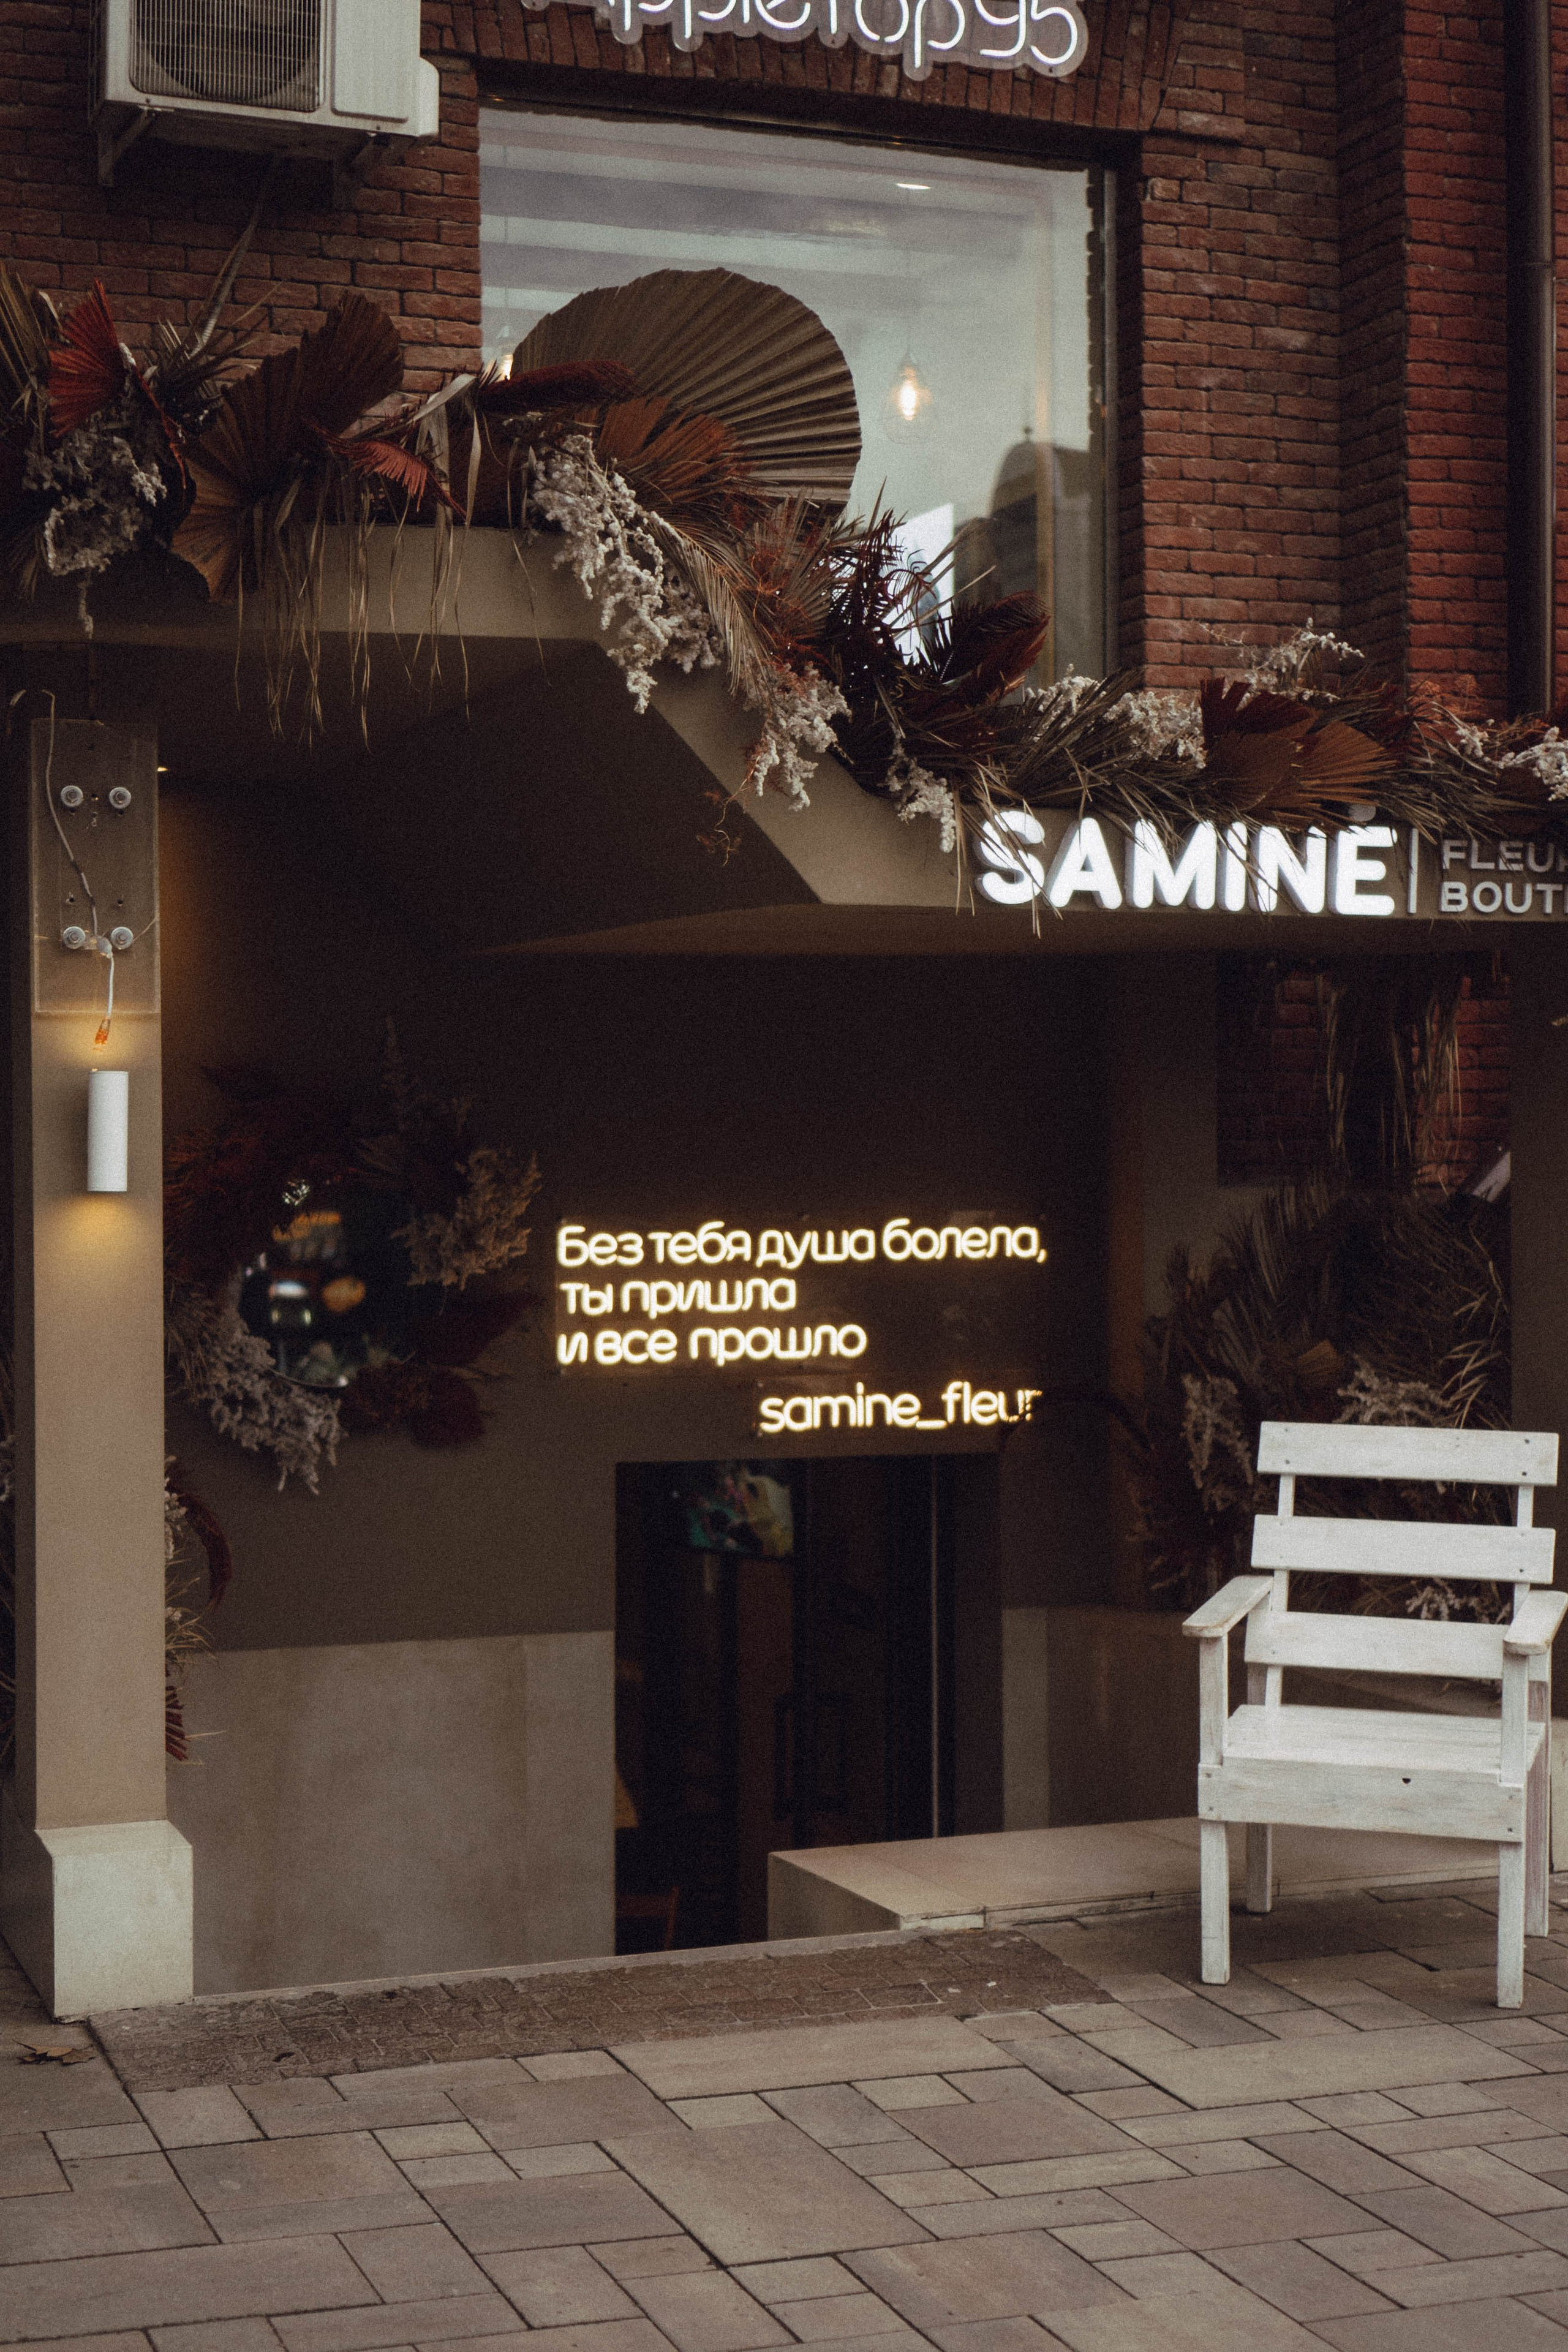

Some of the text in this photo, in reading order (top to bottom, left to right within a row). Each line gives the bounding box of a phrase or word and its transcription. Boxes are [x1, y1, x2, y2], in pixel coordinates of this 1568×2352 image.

[980, 810, 1398, 916] SAMINE
[1442, 839, 1568, 872] FLEU
[557, 1217, 1047, 1270] Без тебя душа болела,
[559, 1276, 797, 1321] ты пришла
[556, 1323, 868, 1367] и все прошло
[760, 1380, 1042, 1433] samine_fleur
